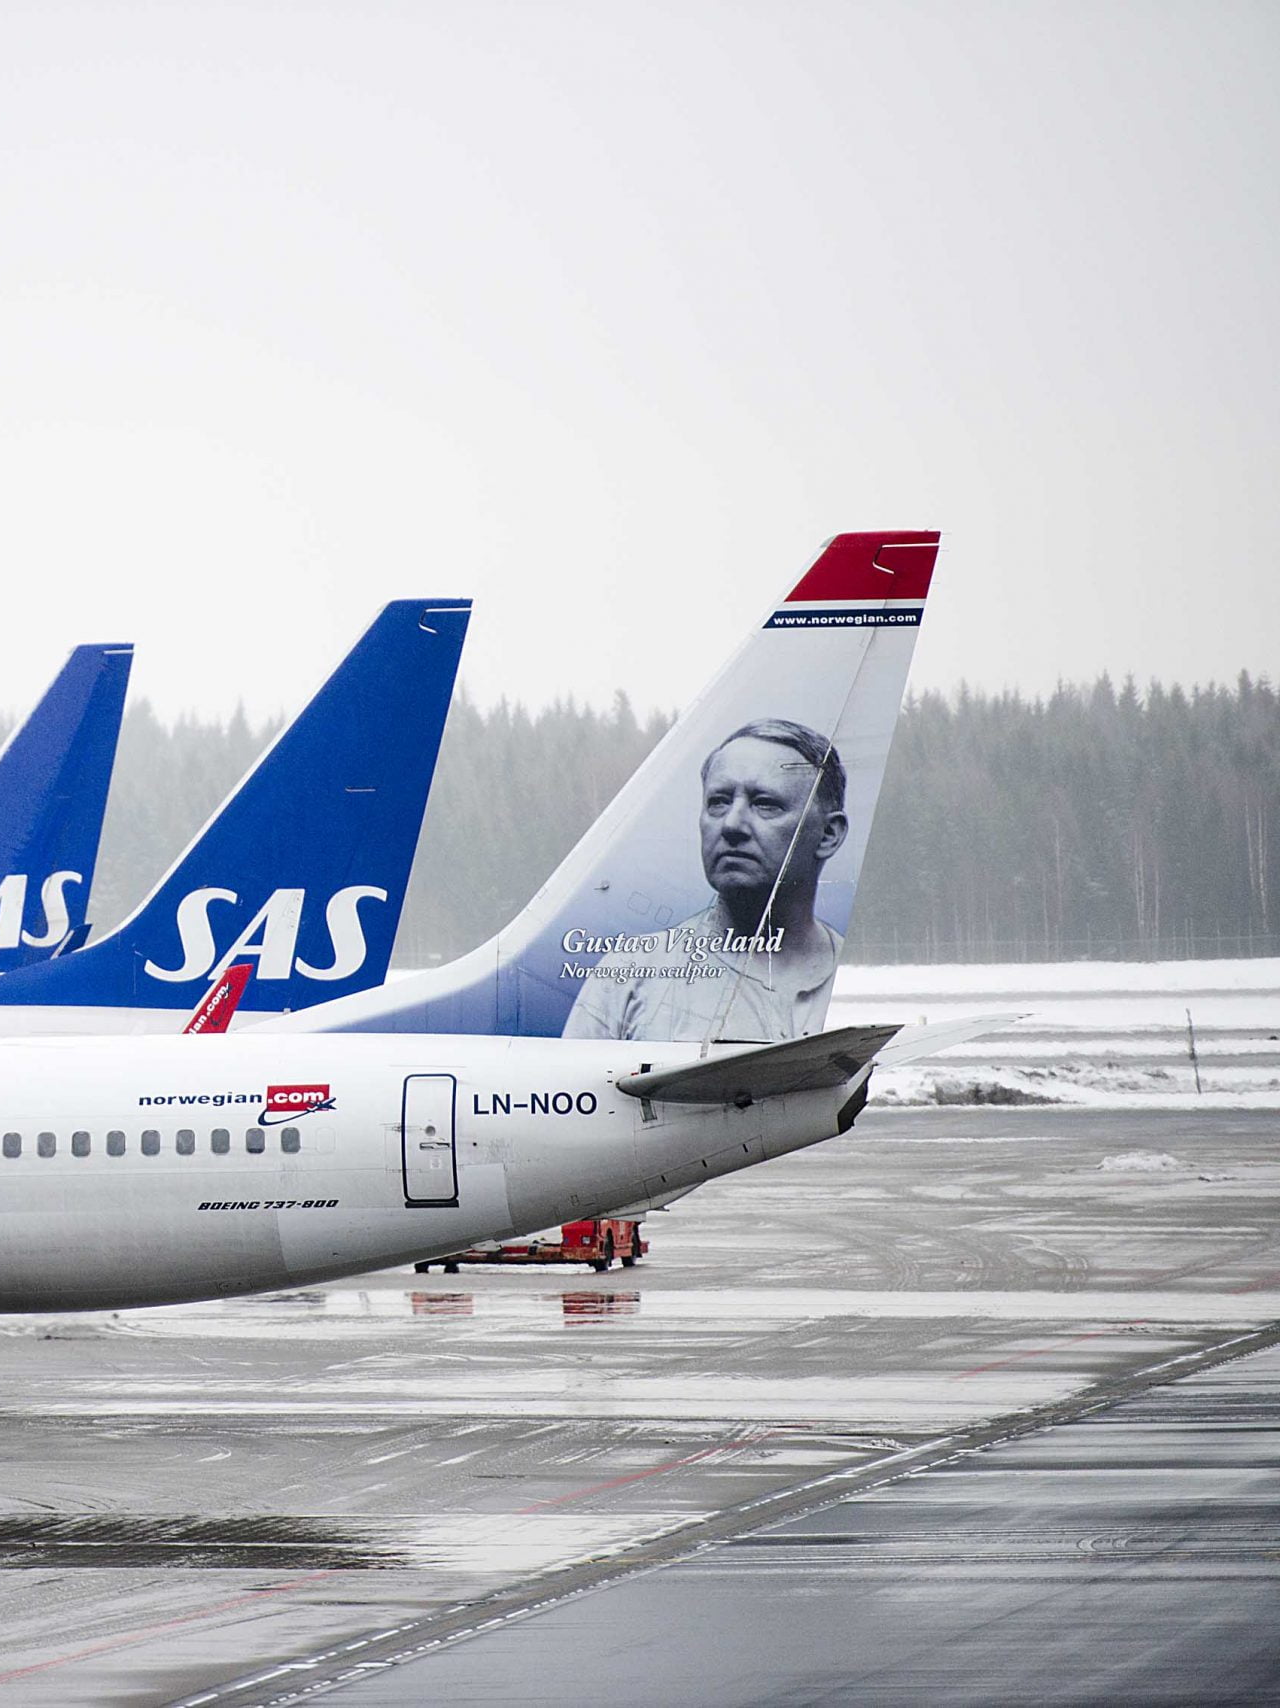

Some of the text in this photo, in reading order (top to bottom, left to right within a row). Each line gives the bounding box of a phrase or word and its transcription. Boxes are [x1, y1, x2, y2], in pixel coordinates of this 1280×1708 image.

[773, 614, 917, 625] www.norwegian.com
[143, 885, 388, 982] SAS
[562, 927, 786, 962] Gustav Vigeland
[559, 962, 727, 985] Norwegian sculptor
[473, 1091, 598, 1115] LN-NOO
[197, 1199, 340, 1211] BOEING 737-800
